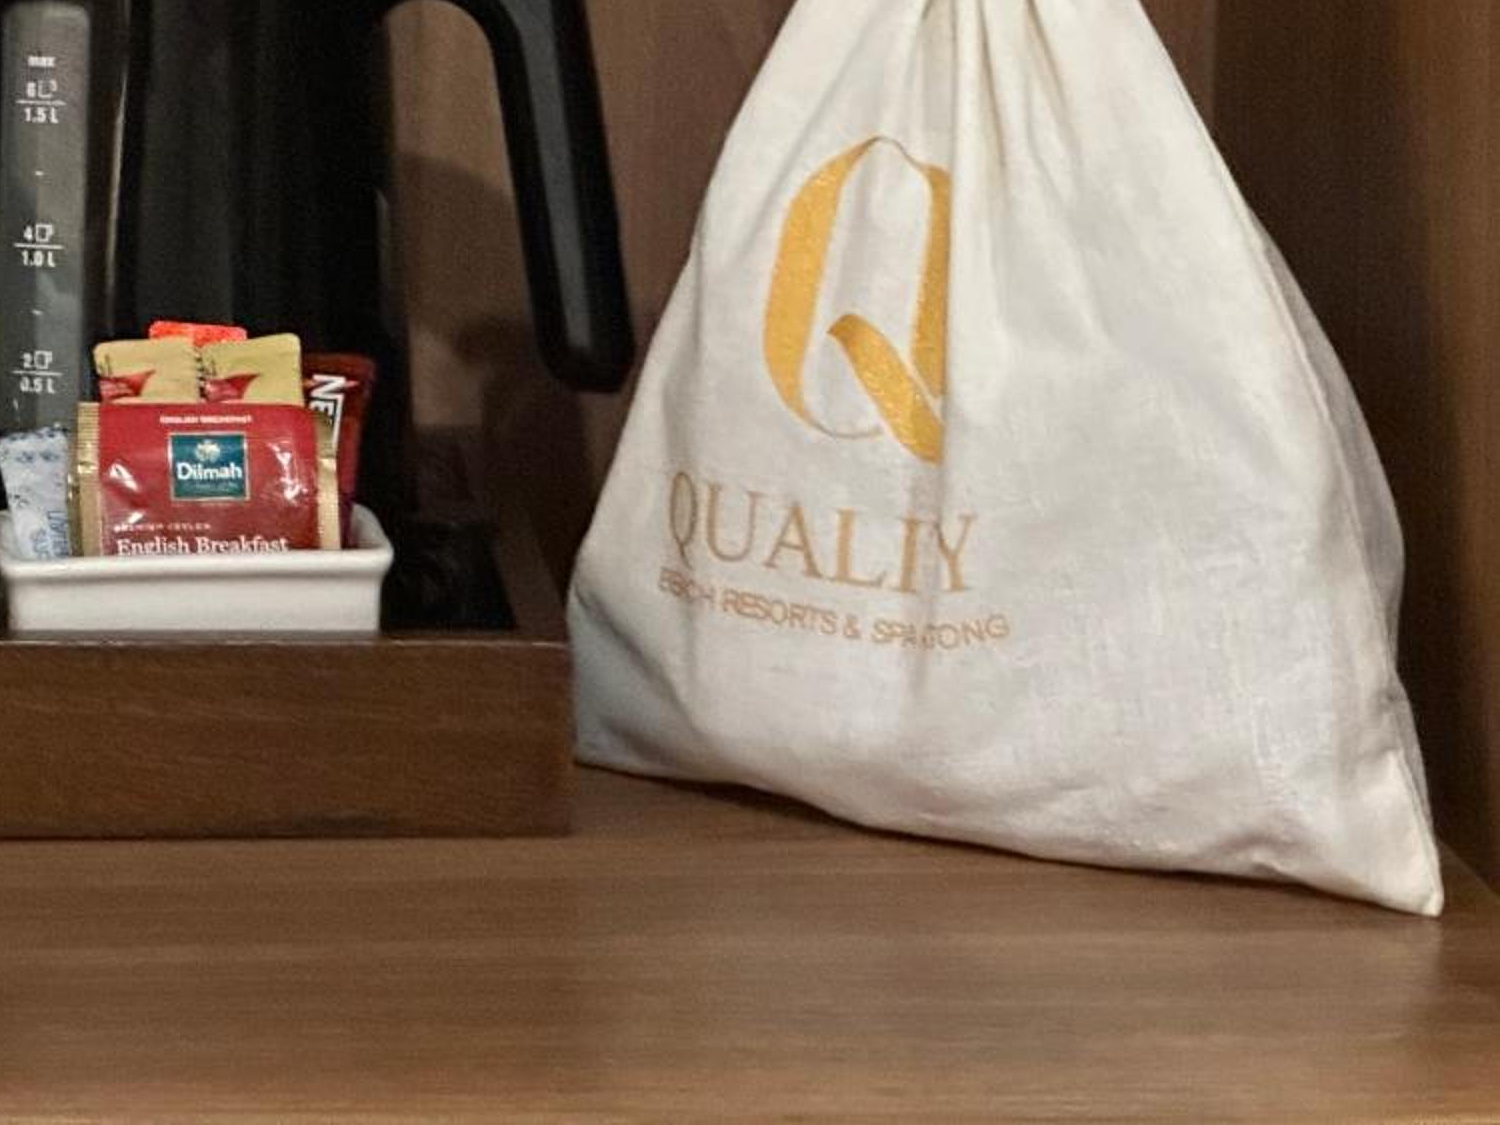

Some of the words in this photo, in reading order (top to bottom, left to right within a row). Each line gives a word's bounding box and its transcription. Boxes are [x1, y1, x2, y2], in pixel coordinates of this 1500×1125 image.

[176, 461, 243, 481] Dilmah
[117, 535, 190, 556] English
[195, 534, 289, 556] Breakfast
[722, 588, 837, 635] RESORTS
[843, 613, 862, 641] &
